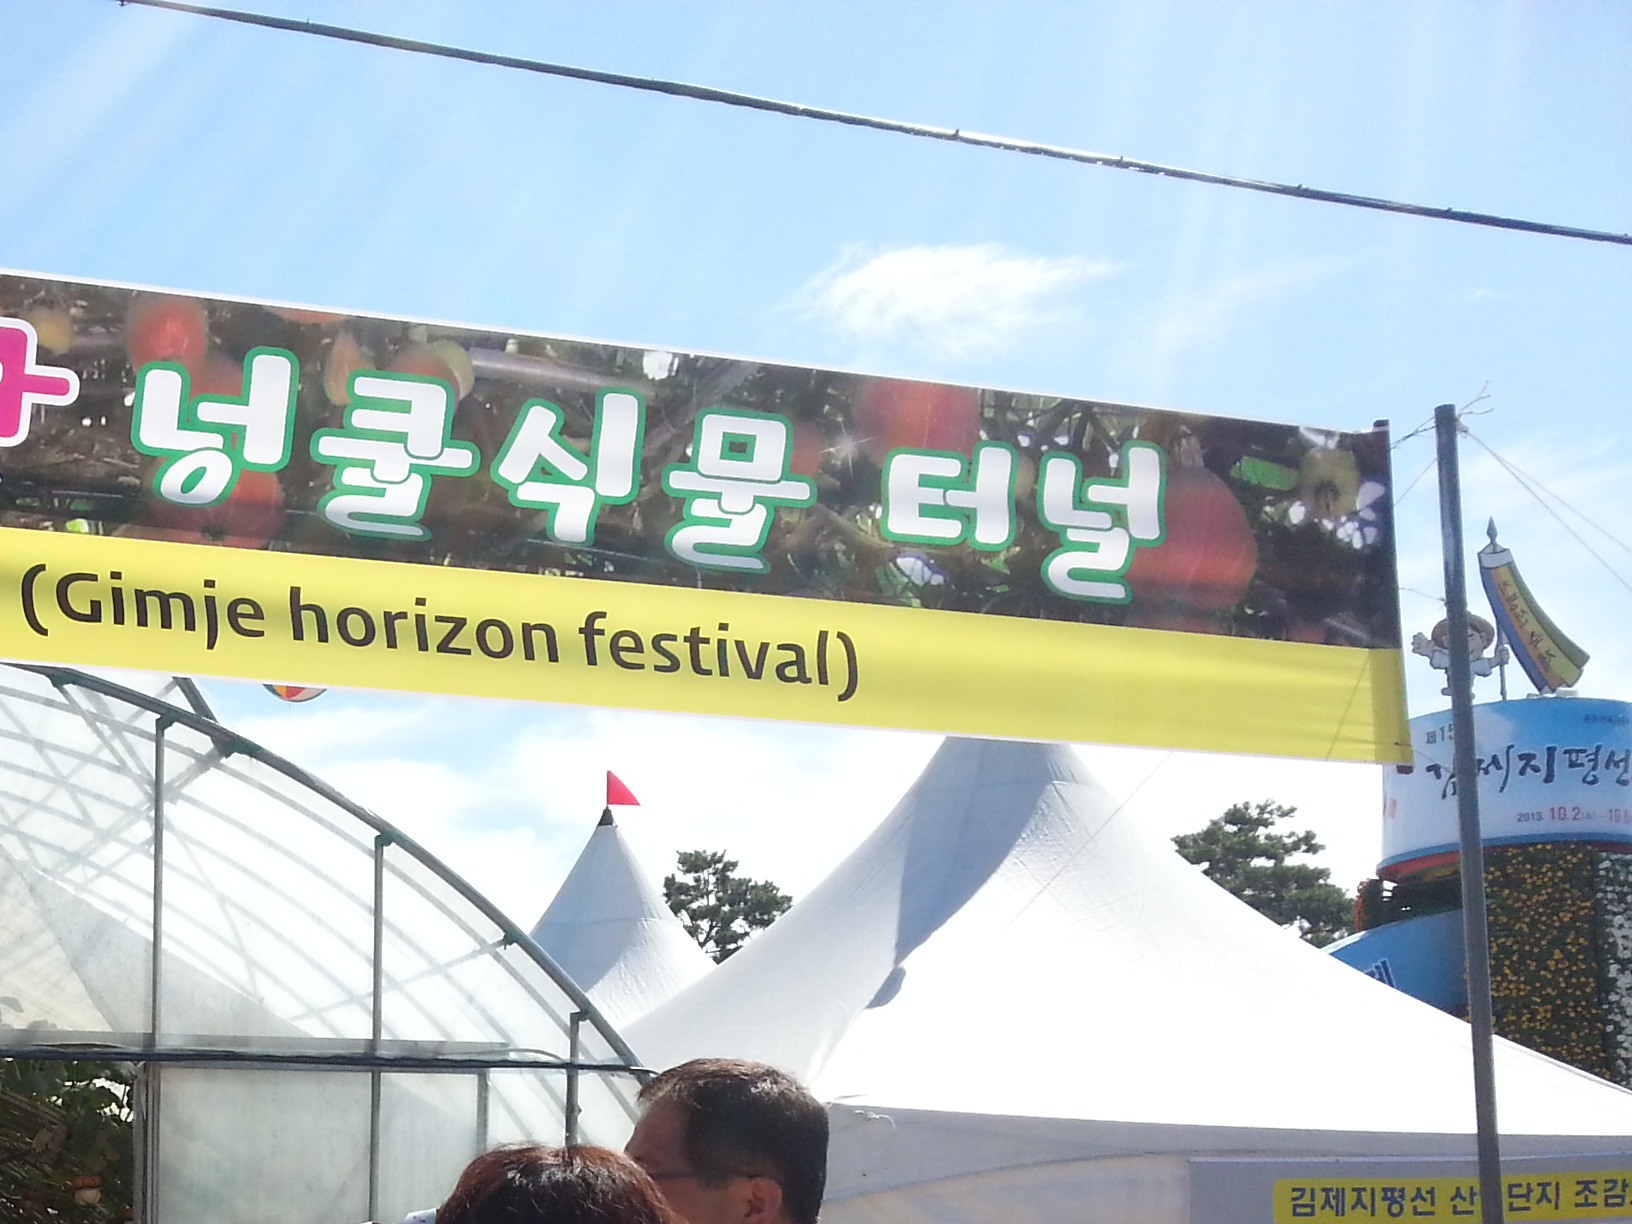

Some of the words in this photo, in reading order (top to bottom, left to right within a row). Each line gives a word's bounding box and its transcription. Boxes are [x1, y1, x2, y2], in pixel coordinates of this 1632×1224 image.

[130, 346, 816, 574] 넝쿨식물
[881, 439, 1165, 603] 터널
[20, 562, 266, 652] (Gimje
[291, 587, 559, 664] horizon
[579, 610, 859, 702] festival)
[1290, 1186, 1436, 1218] 김제지평선
[1450, 1182, 1560, 1216] 산단지
[1575, 1179, 1632, 1208] 조감
